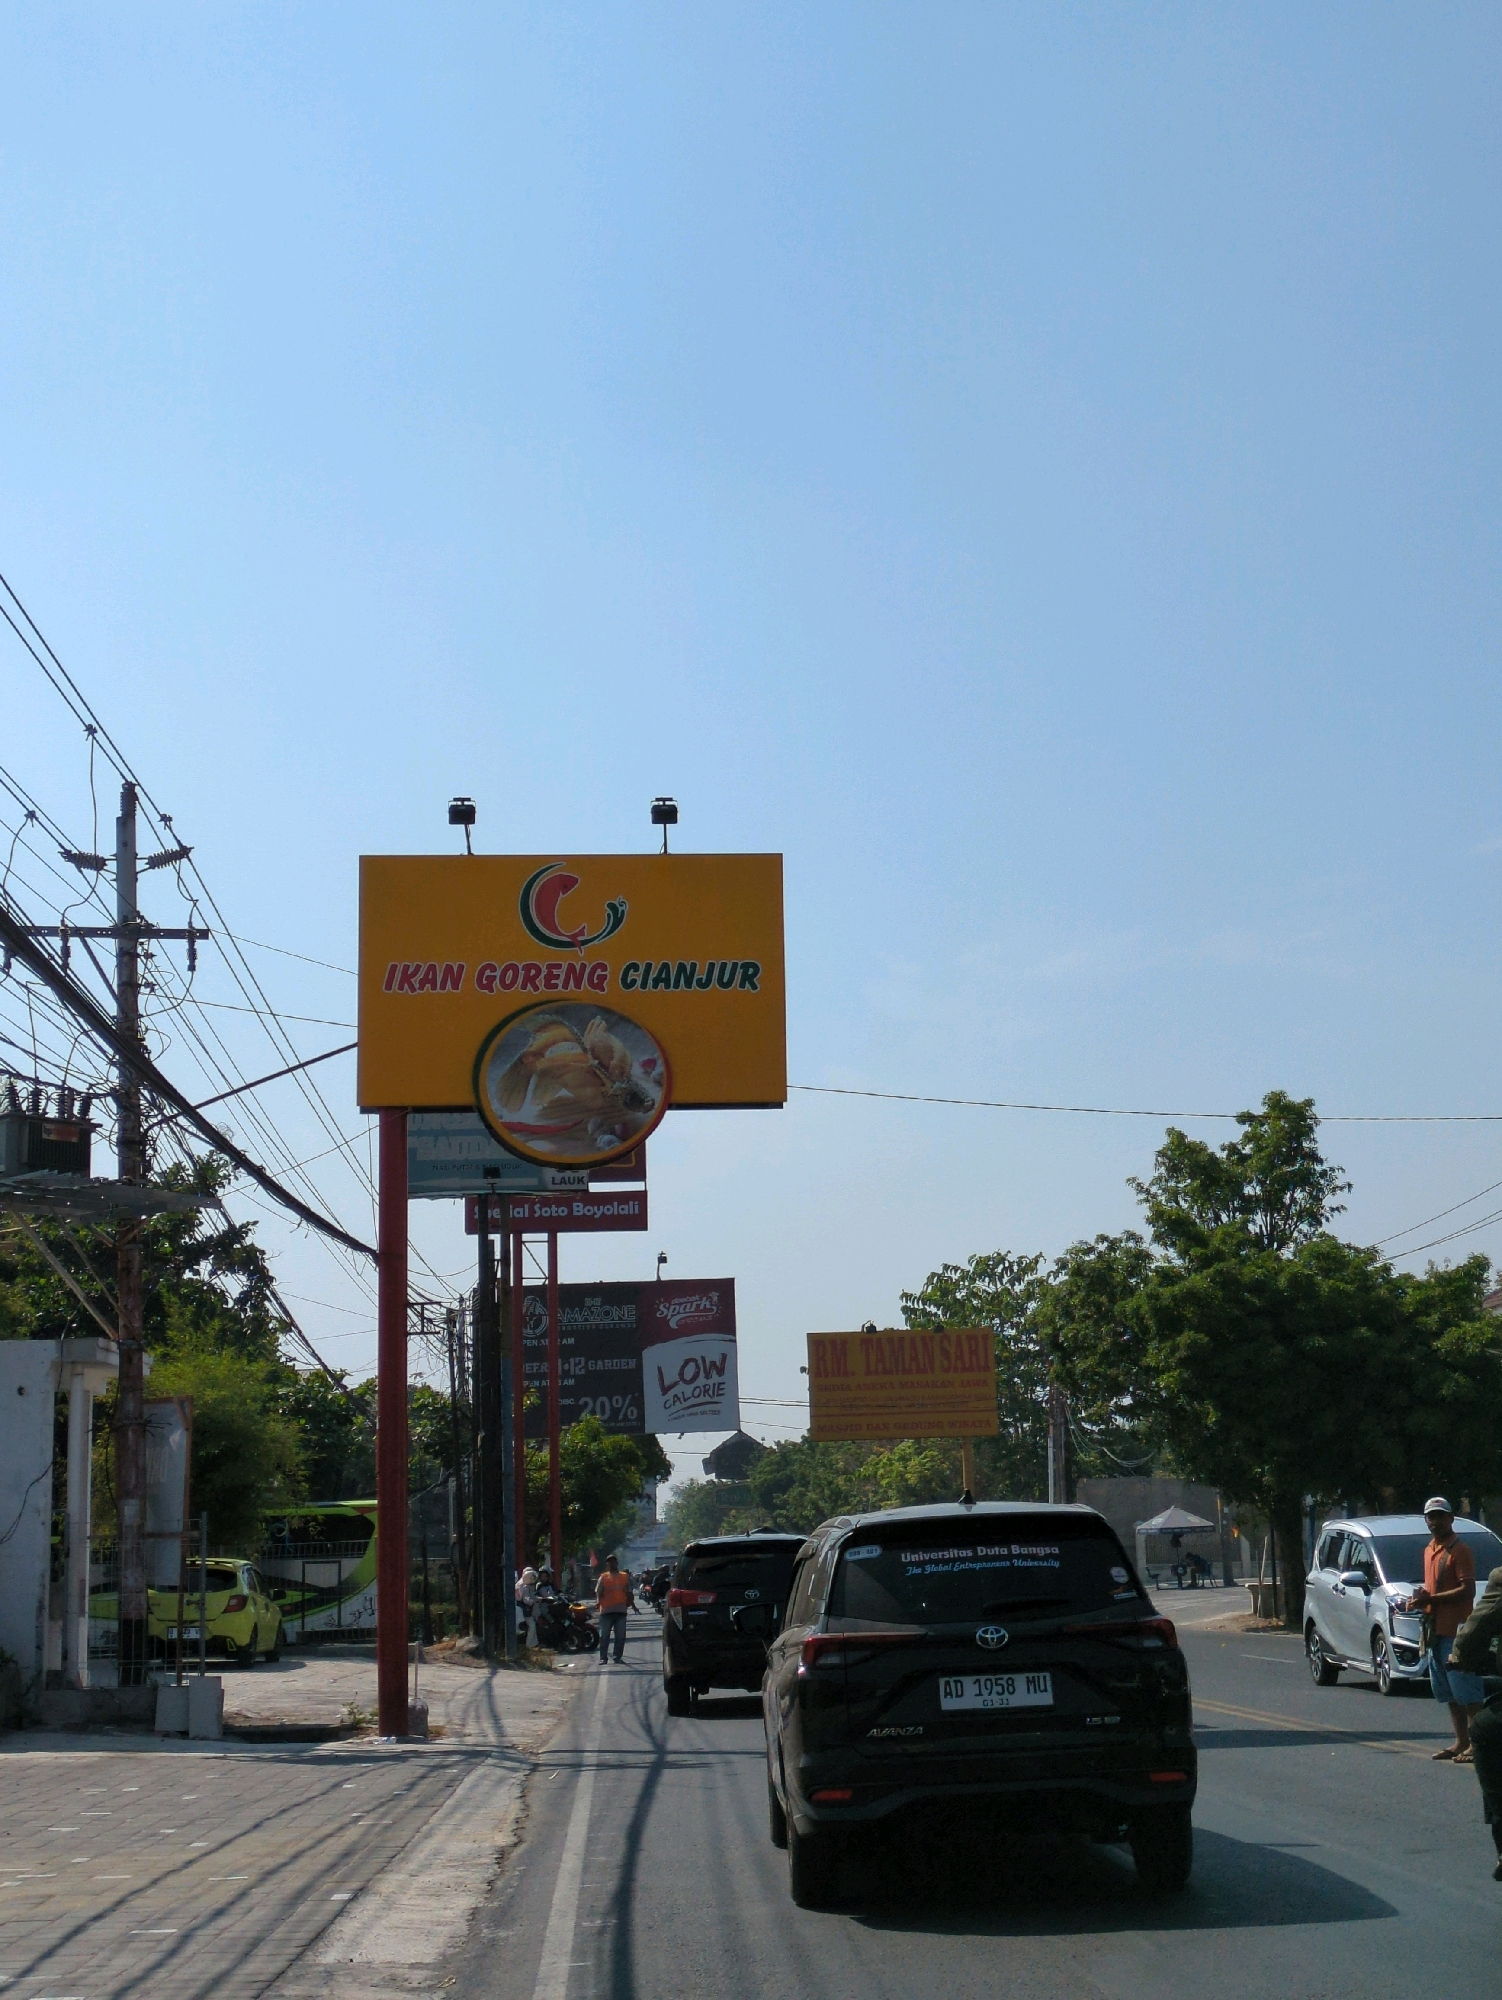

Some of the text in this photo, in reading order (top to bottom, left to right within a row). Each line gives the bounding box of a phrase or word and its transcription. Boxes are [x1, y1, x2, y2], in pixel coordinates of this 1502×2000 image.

[383, 959, 762, 994] IKAN GORENG CIANJUR
[551, 1176, 586, 1186] LAUK
[473, 1201, 639, 1220] peial Soto Boyolali
[522, 1339, 538, 1347] PEN
[562, 1337, 575, 1345] AM
[588, 1358, 637, 1370] GARDEN
[813, 1338, 857, 1378] RM.
[523, 1380, 540, 1388] PEN
[563, 1378, 575, 1386] AM
[657, 1353, 728, 1396] LOW
[663, 1382, 726, 1409] CALORIE
[578, 1395, 638, 1421] 20%
[901, 1544, 1060, 1562] Universitas Duta Bangsa
[905, 1566, 922, 1576] The
[923, 1562, 952, 1574] Global
[1012, 1558, 1060, 1569] University
[943, 1675, 1048, 1699] AD 1958 MU
[866, 1726, 924, 1737] AVANZA
